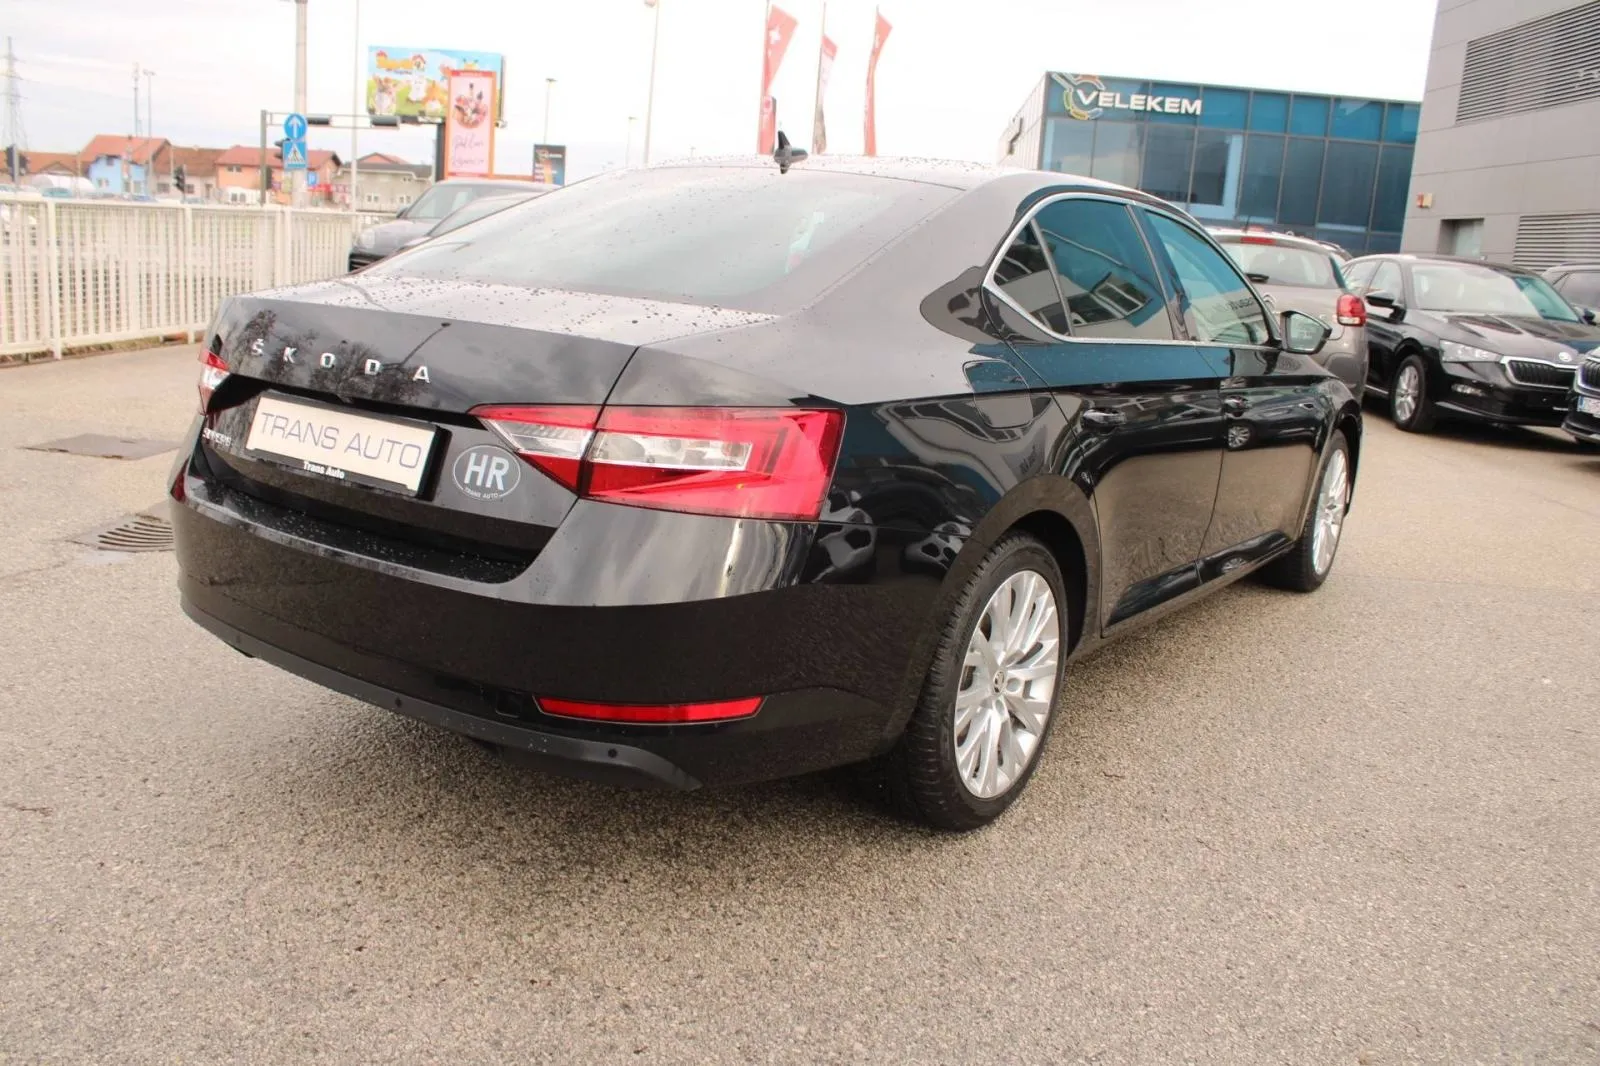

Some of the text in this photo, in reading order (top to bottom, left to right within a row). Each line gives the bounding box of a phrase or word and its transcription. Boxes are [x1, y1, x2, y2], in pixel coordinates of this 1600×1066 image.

[1077, 89, 1202, 115] VELEKEM
[252, 338, 430, 384] ŠKODA
[261, 412, 422, 469] TRANS AUTO
[303, 460, 345, 479] Trans Auto
[463, 452, 509, 491] HR
